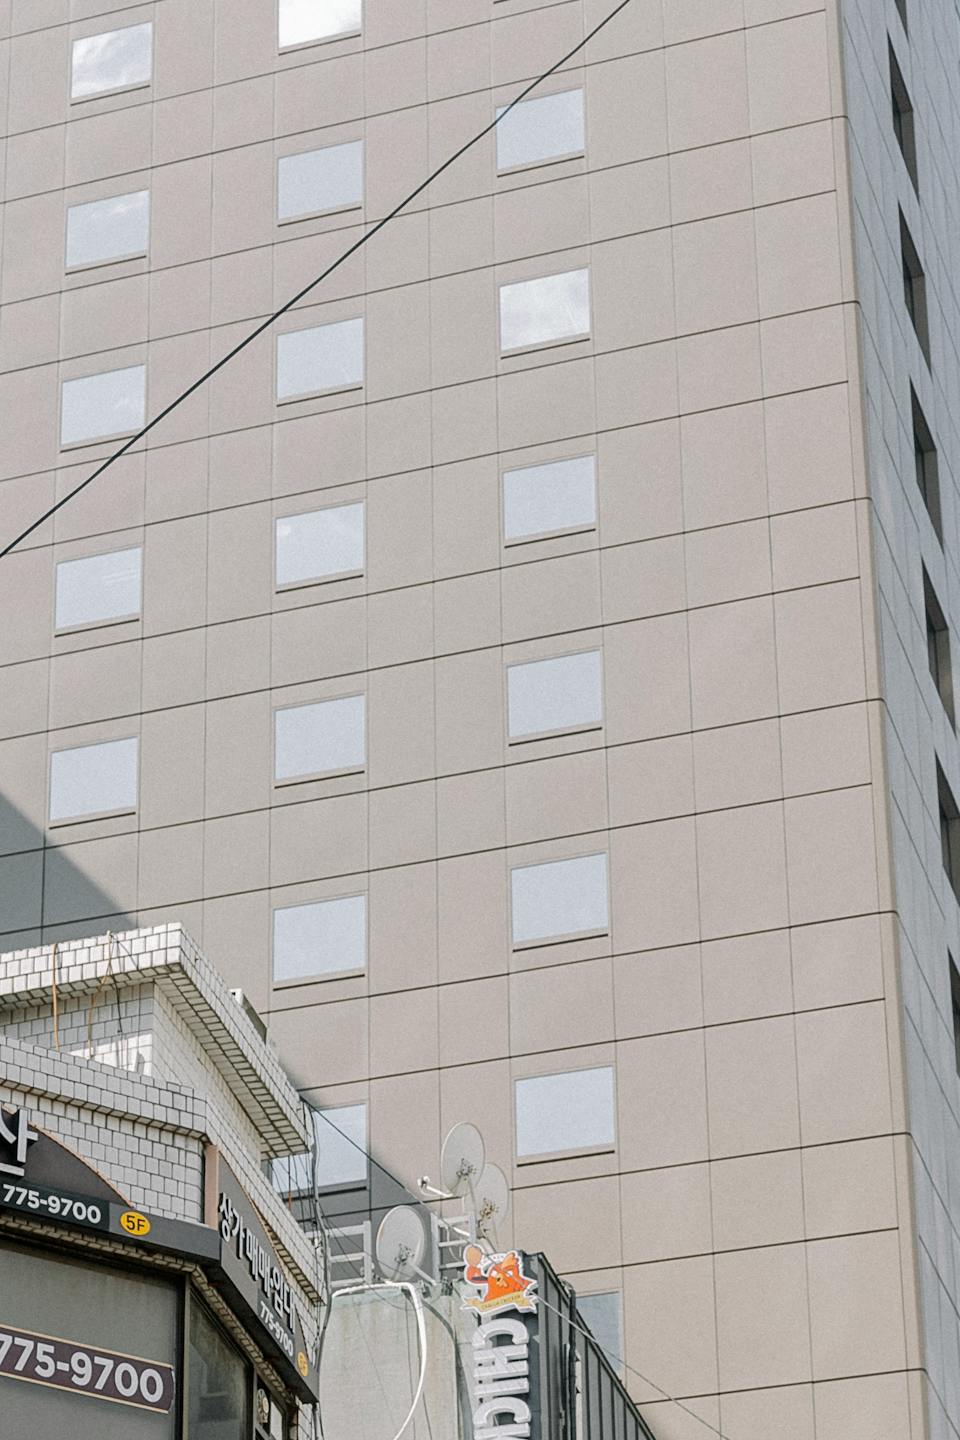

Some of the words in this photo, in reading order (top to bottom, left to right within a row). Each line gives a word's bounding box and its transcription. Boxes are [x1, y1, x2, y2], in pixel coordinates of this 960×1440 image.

[2, 1183, 102, 1225] 775-9700
[124, 1214, 147, 1233] 5F
[260, 1301, 295, 1356] 775-9700
